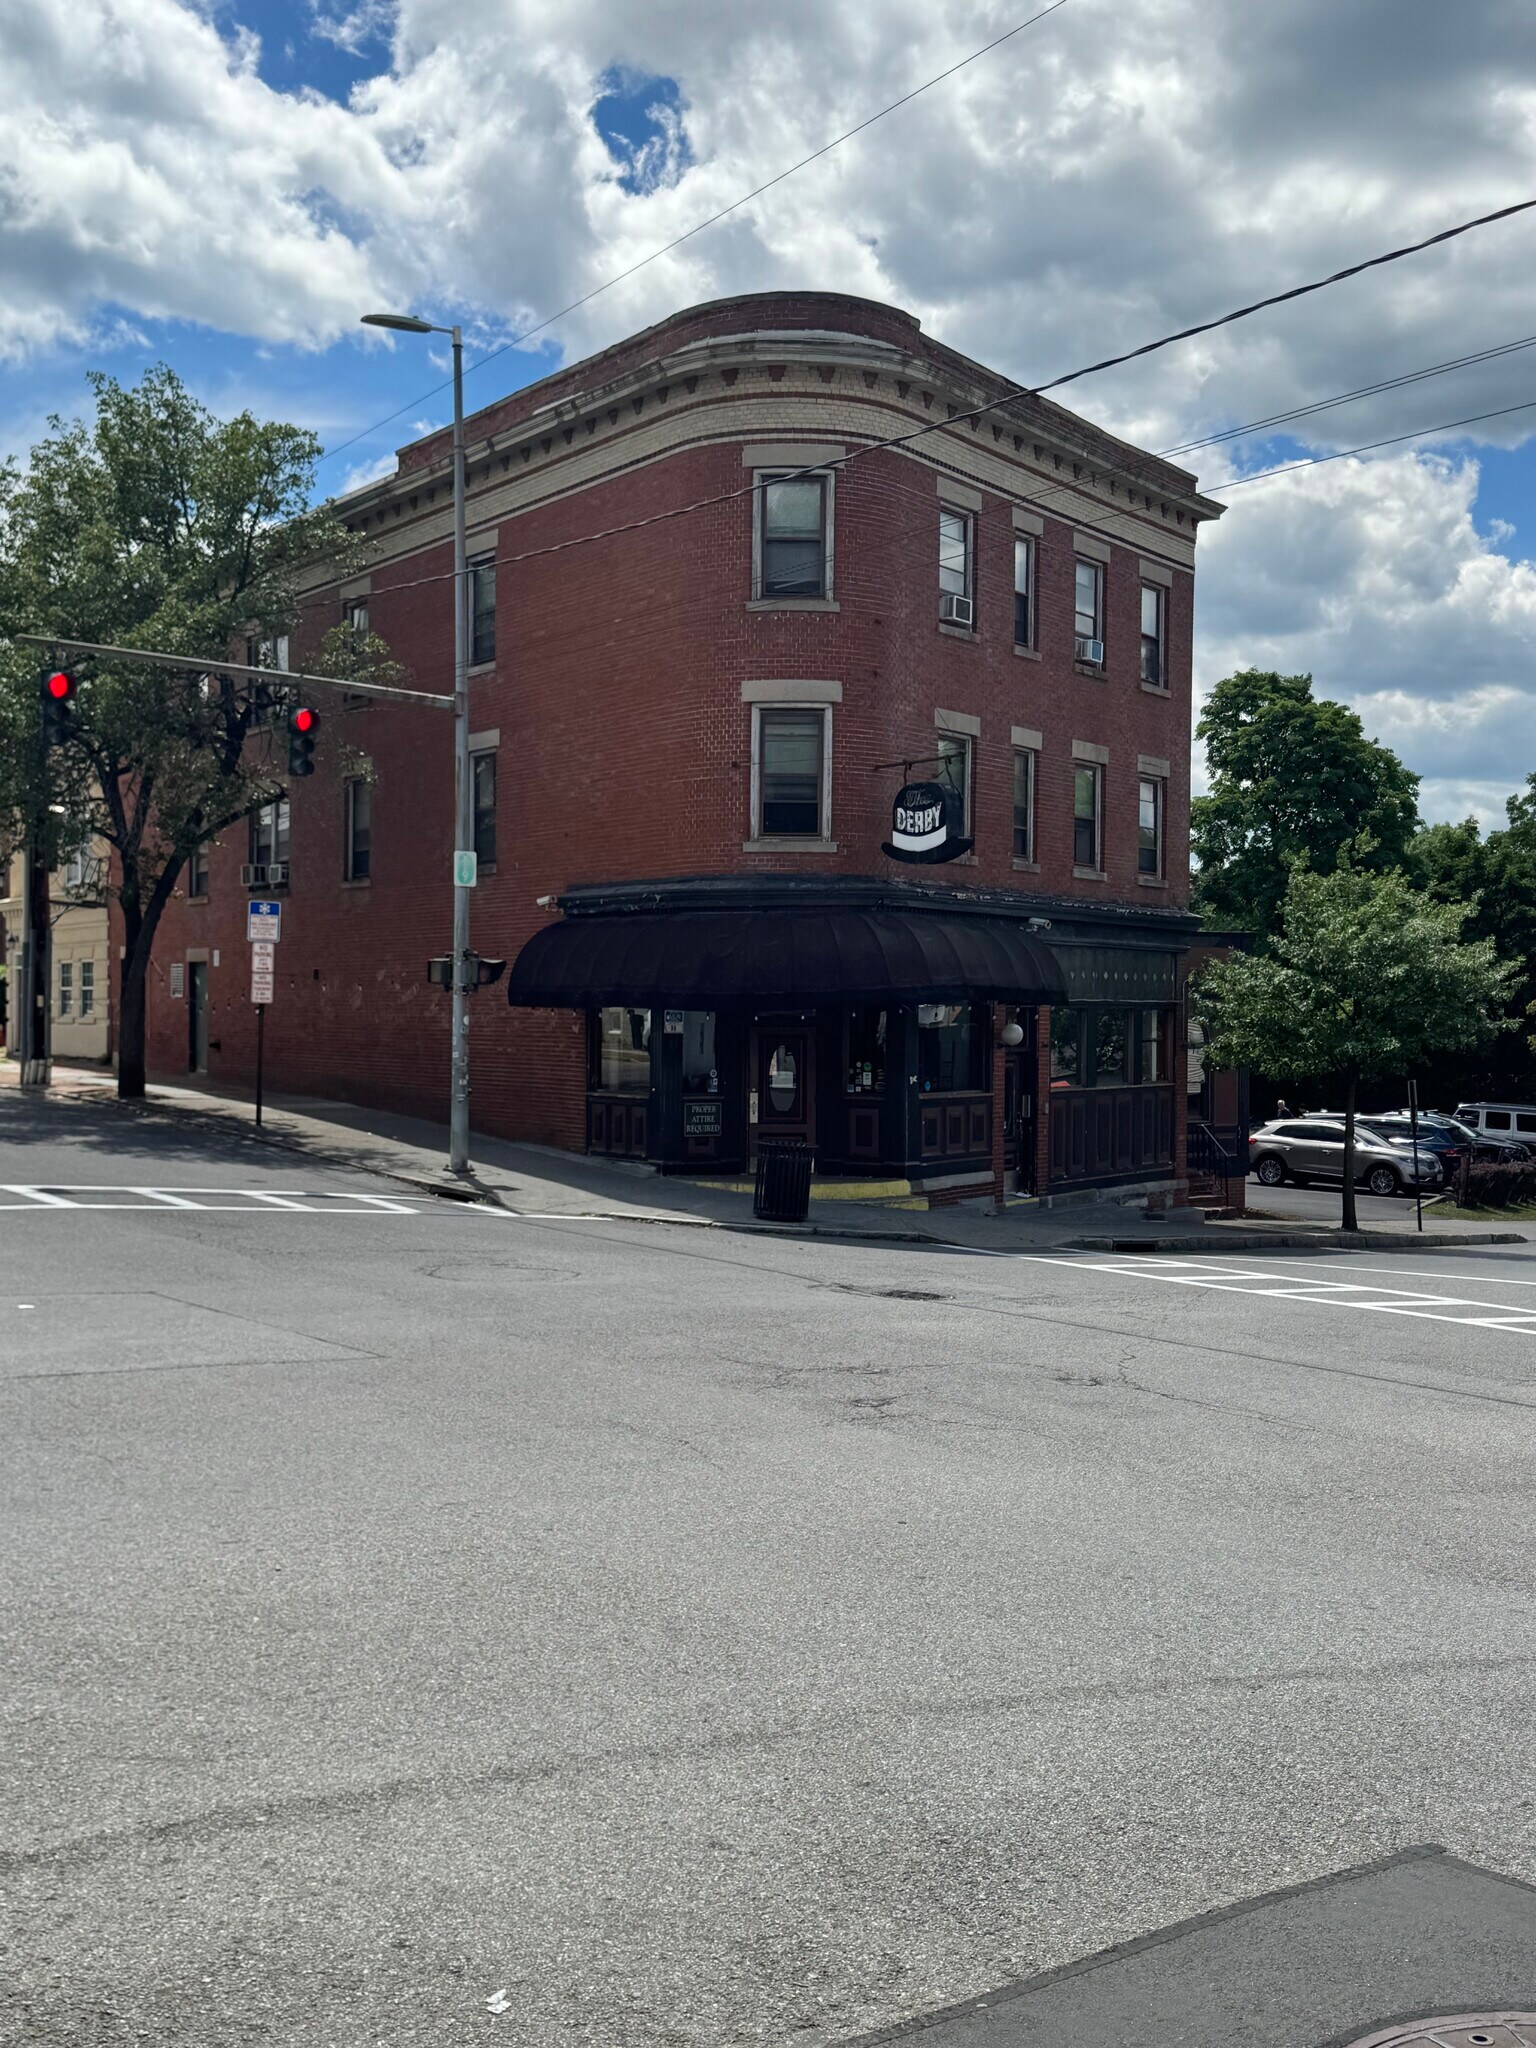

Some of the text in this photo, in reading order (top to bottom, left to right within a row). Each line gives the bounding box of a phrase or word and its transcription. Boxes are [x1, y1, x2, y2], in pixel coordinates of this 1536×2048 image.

[904, 788, 934, 807] The
[896, 801, 943, 834] DERBY
[691, 1105, 717, 1113] PROPER
[691, 1115, 716, 1123] ATTIRE
[686, 1124, 721, 1134] REQUIRED
